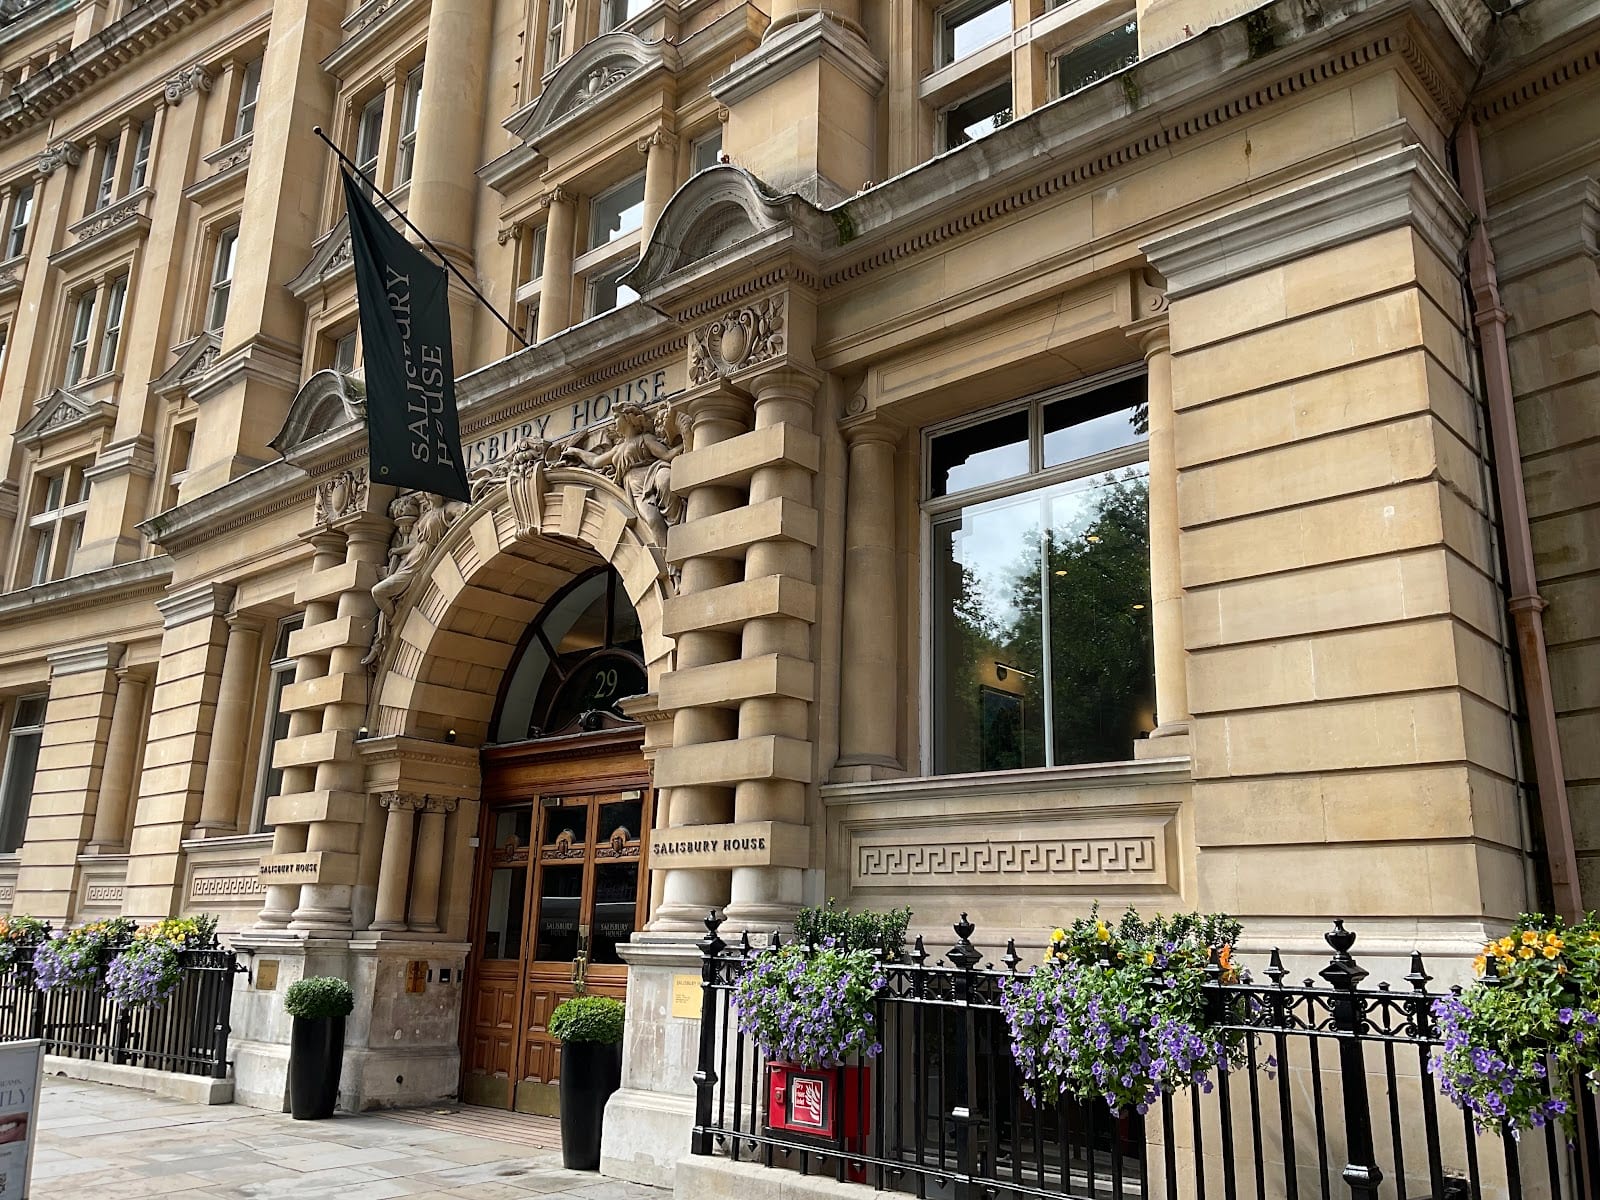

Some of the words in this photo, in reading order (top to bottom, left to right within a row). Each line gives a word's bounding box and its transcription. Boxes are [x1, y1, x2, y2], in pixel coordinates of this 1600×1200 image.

[569, 370, 666, 431] HOUSE
[594, 669, 618, 699] 29
[653, 840, 718, 855] SALISBURY
[723, 838, 766, 851] HOUSE
[260, 864, 294, 875] SALISBURY
[295, 863, 318, 873] HOUSE
[546, 922, 573, 930] SALISBURY
[600, 922, 629, 931] SALISBURY
[0, 1086, 31, 1107] TLY
